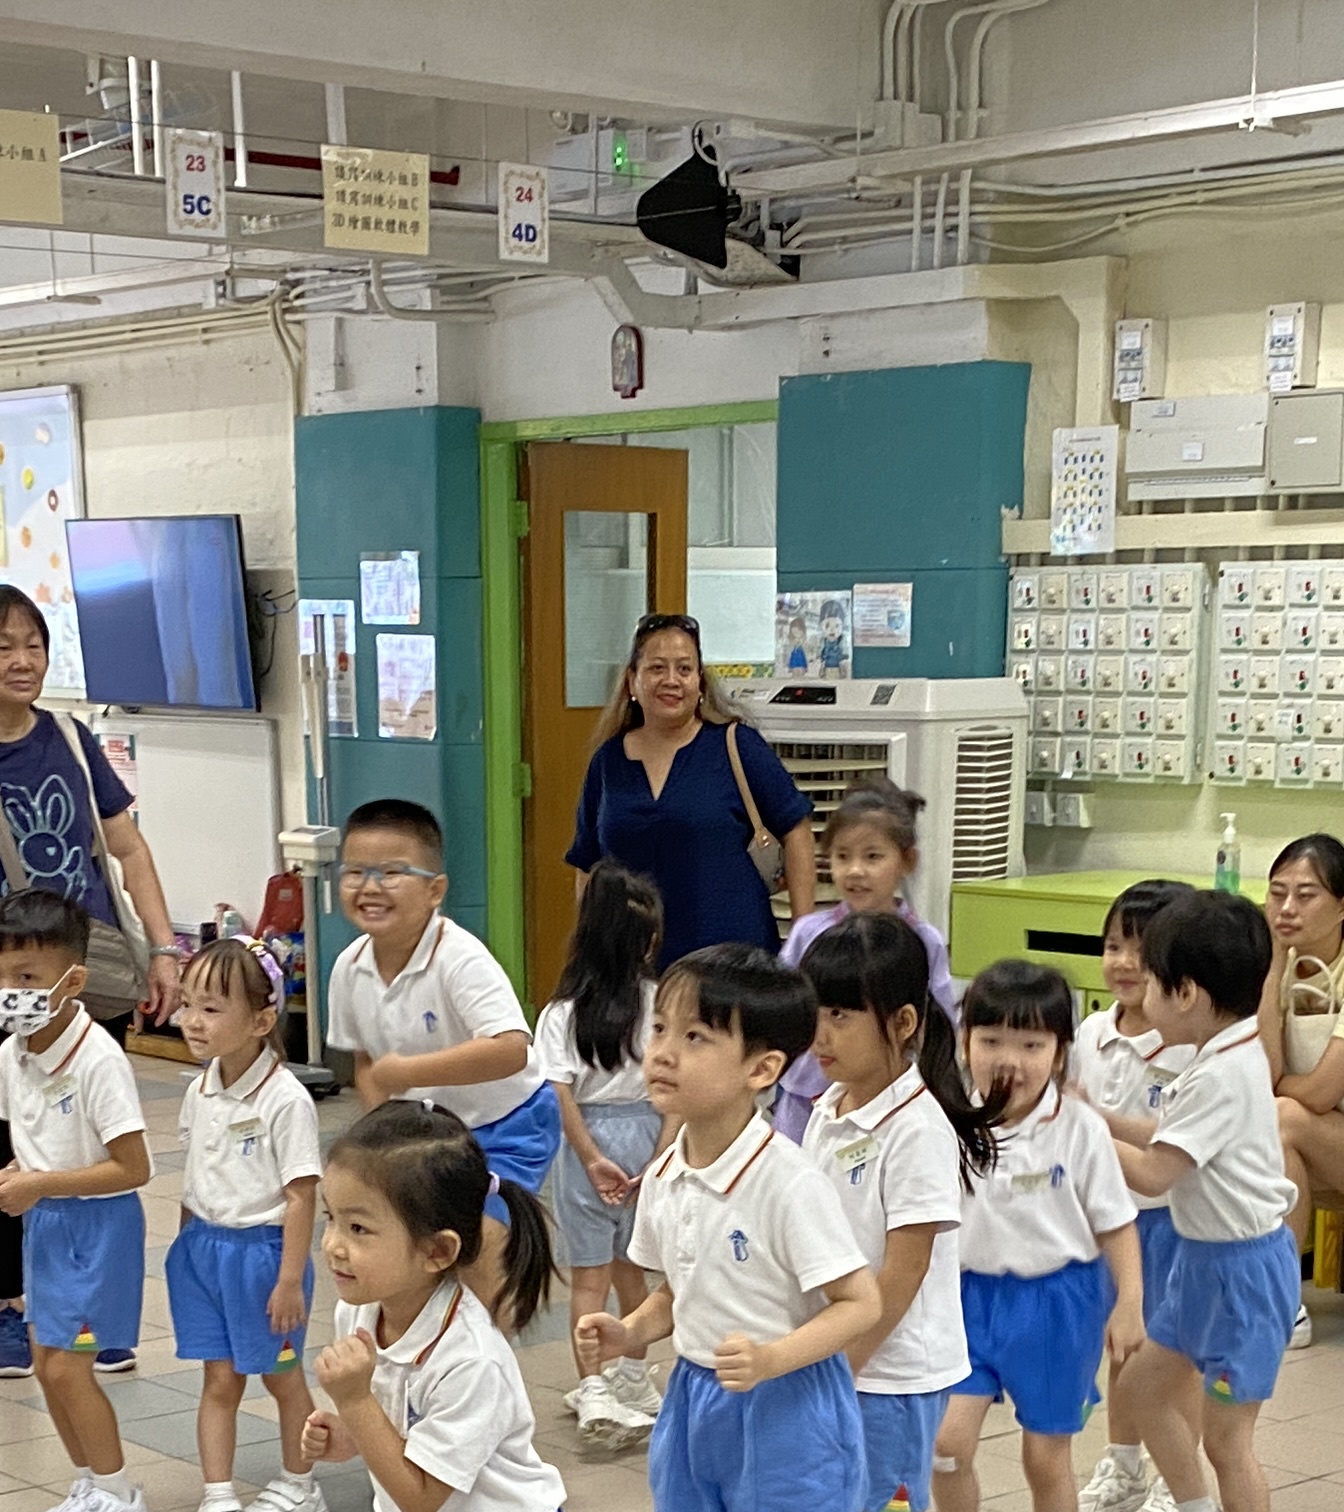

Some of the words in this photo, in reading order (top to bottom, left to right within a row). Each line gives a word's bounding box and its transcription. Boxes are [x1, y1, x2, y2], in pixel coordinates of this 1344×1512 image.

[185, 154, 206, 172] 23
[515, 186, 533, 203] 24
[182, 194, 213, 216] 5C
[511, 223, 538, 243] 4D
